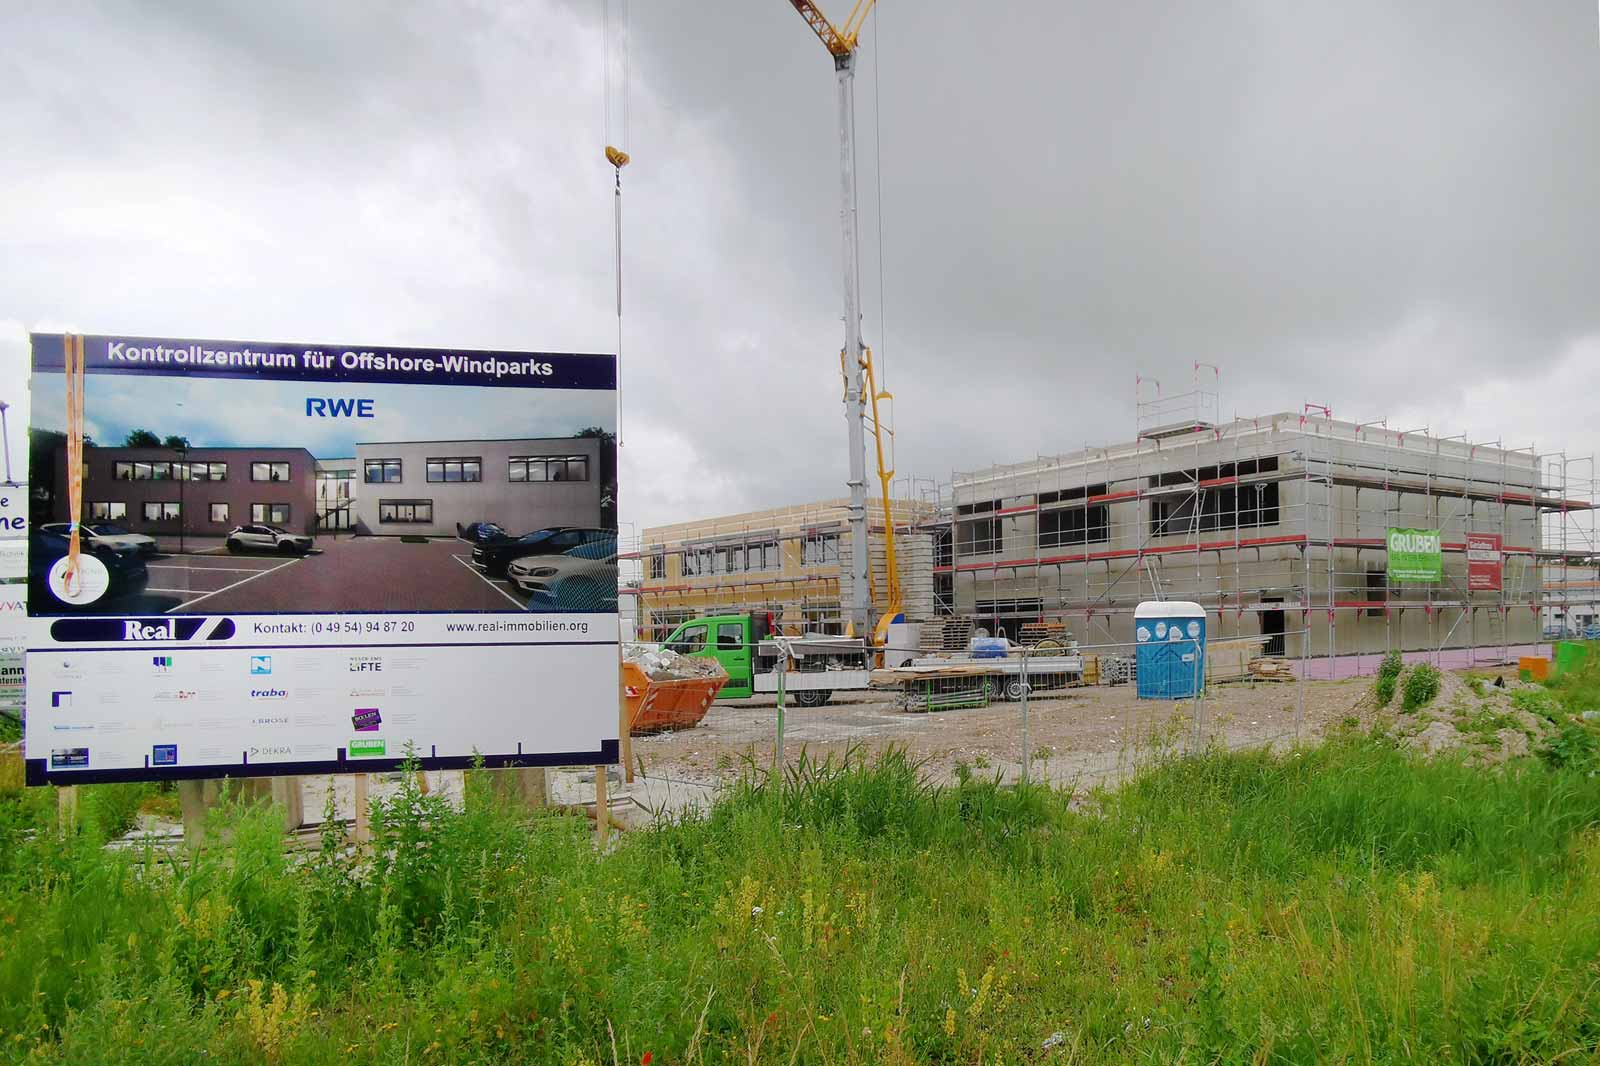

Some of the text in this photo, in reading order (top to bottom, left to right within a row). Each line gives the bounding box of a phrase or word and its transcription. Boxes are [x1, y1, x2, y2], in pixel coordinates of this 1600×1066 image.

[106, 341, 553, 378] Kontrollzentrum für Offshore-Windparks
[306, 397, 375, 418] RWE
[1391, 532, 1440, 553] GRUBEN
[123, 617, 176, 641] Real
[253, 621, 415, 635] Kontakt: (0 49 54) 94 87 20
[446, 620, 589, 634] www.real-immobilien.org
[262, 746, 292, 755] DEKRA
